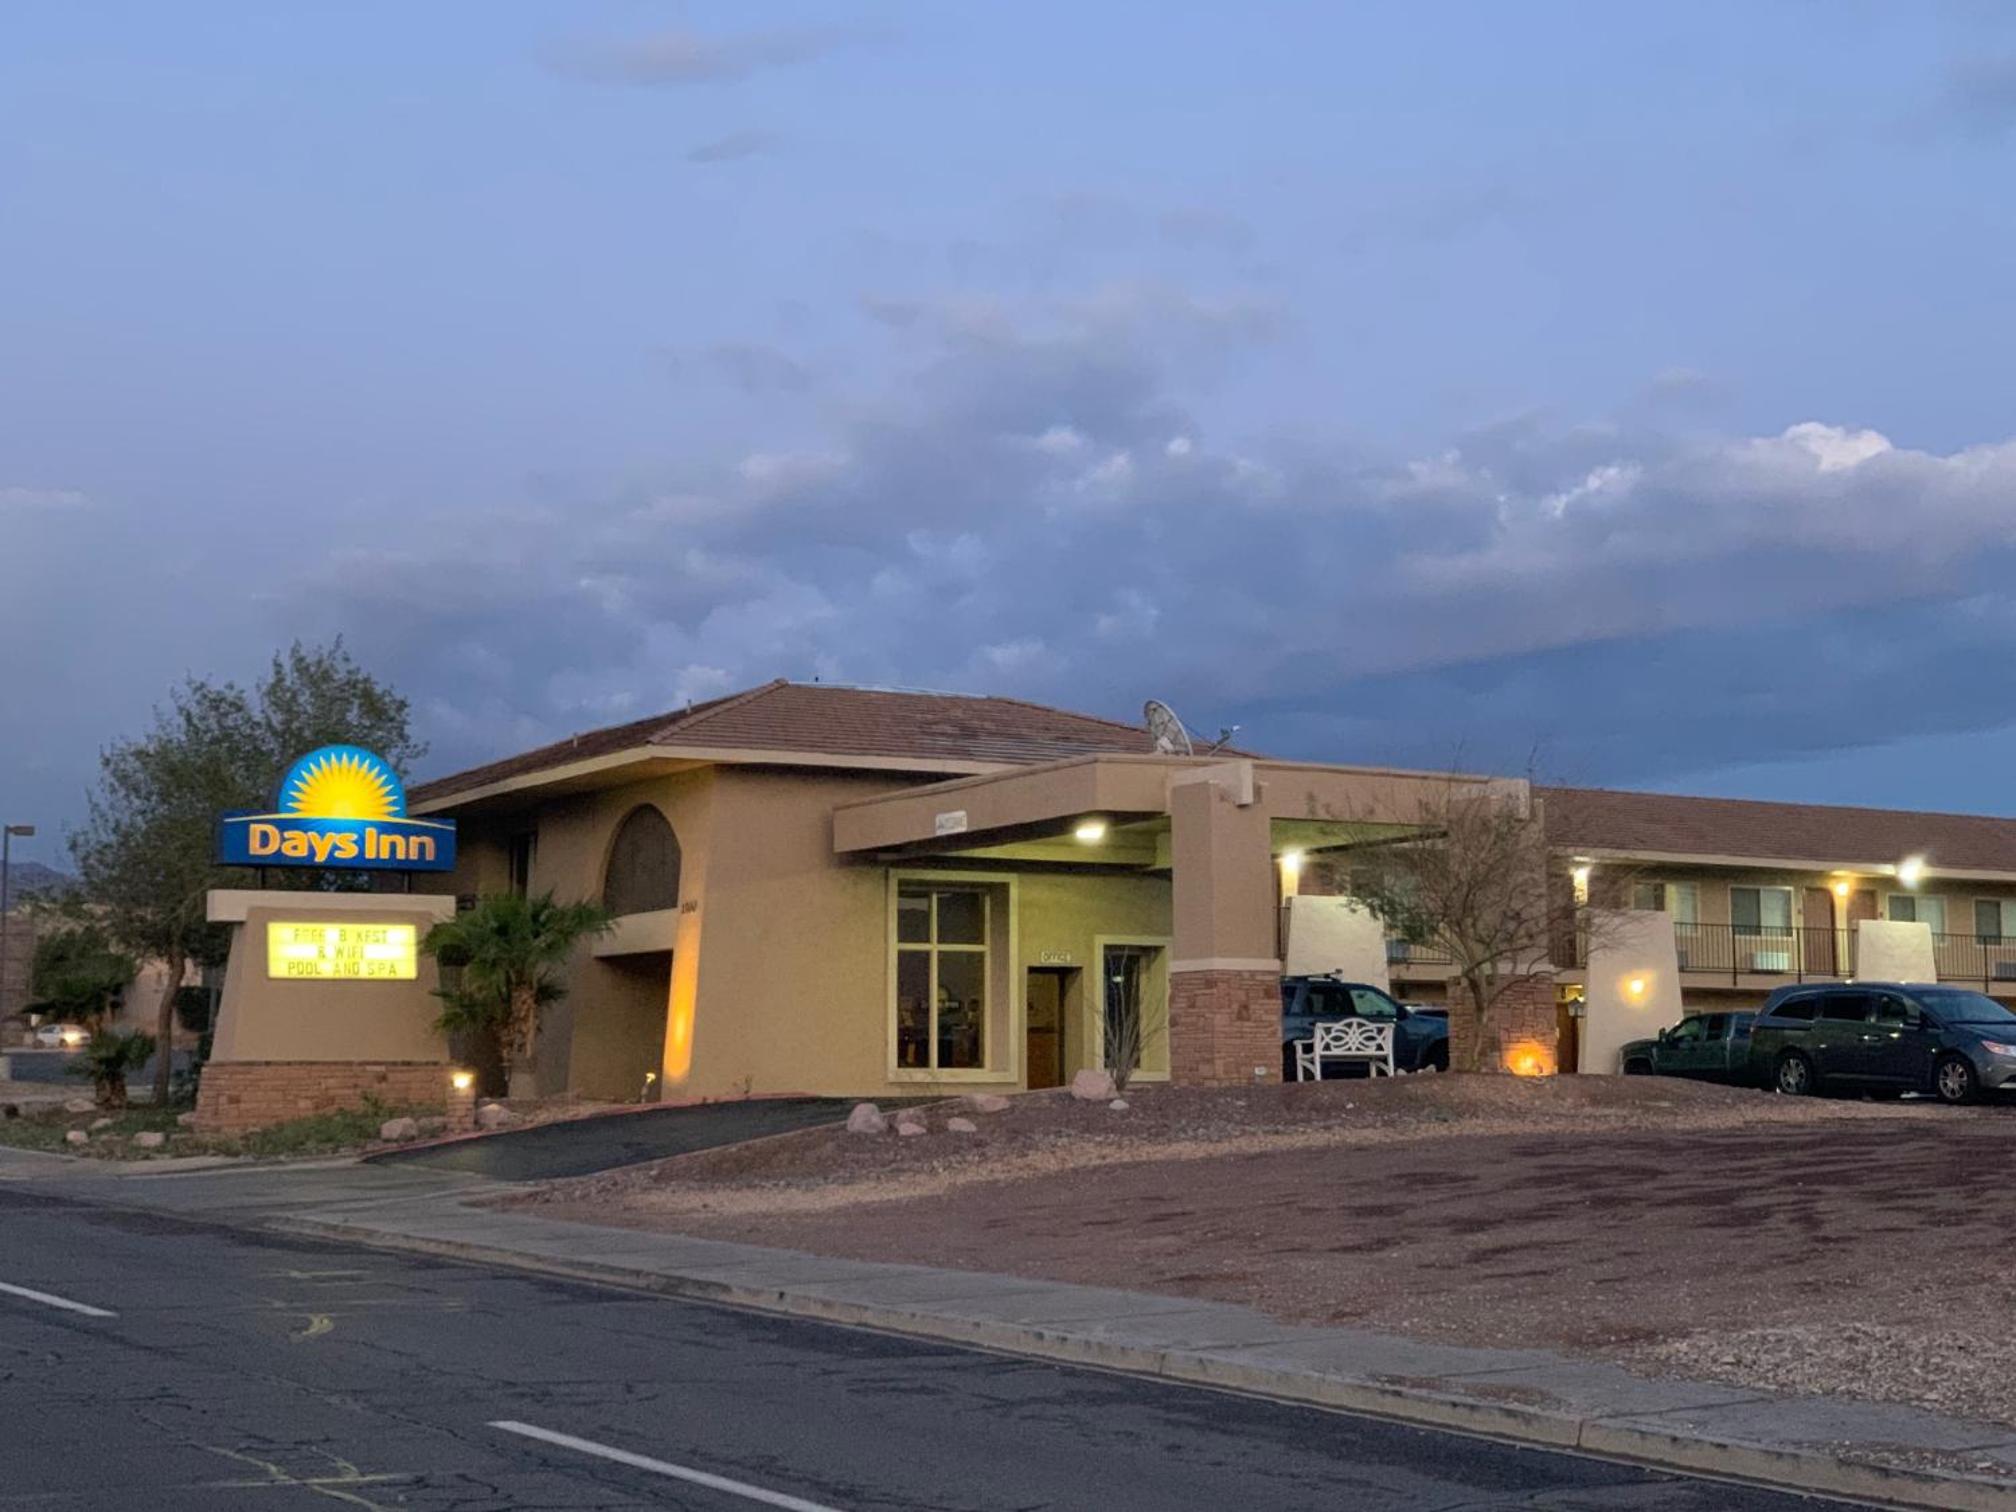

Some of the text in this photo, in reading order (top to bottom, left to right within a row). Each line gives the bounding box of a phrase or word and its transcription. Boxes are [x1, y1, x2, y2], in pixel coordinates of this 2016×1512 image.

[249, 823, 435, 863] Days Inn
[335, 945, 364, 960] WIFI
[288, 961, 397, 976] POOL AND SPA
